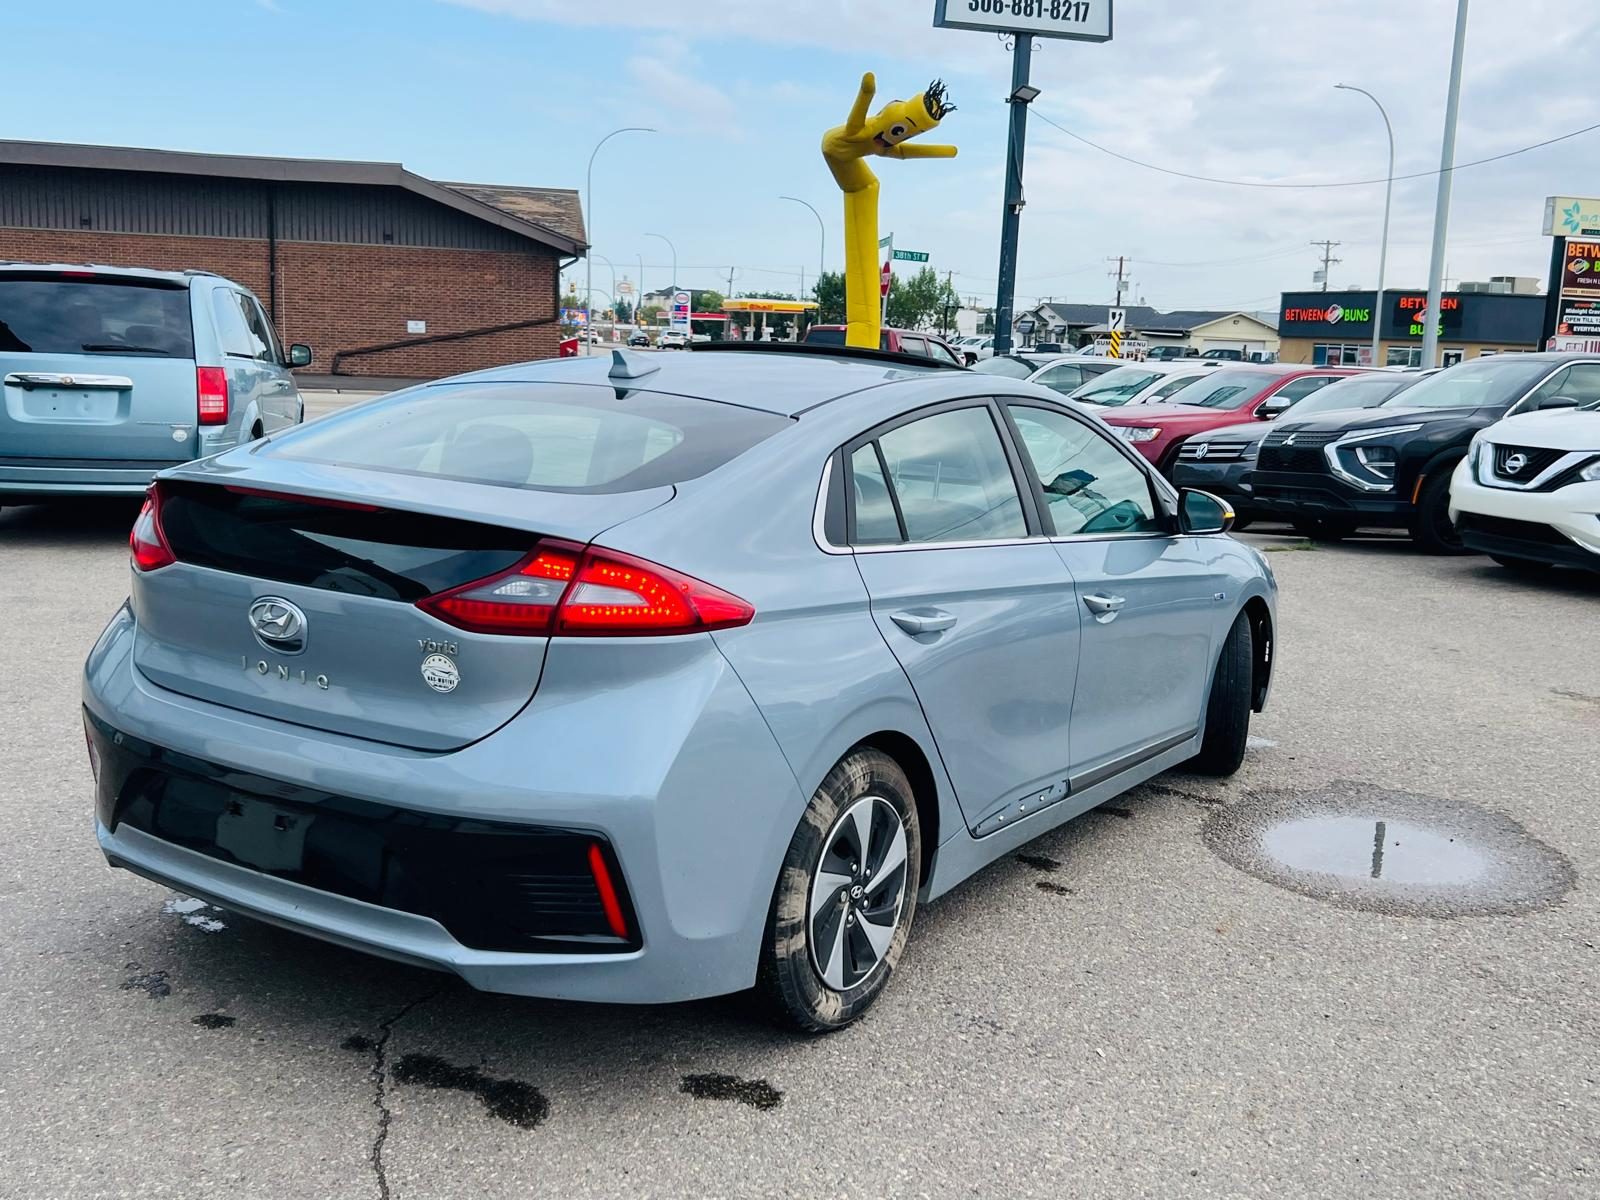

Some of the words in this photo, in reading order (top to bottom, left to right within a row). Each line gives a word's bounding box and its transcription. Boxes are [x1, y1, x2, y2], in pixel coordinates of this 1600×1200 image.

[913, 252, 920, 260] ST
[1285, 308, 1324, 321] BETWEEN
[1344, 309, 1369, 322] BUNS
[1409, 324, 1443, 336] BUS
[241, 655, 329, 690] IONIQ
